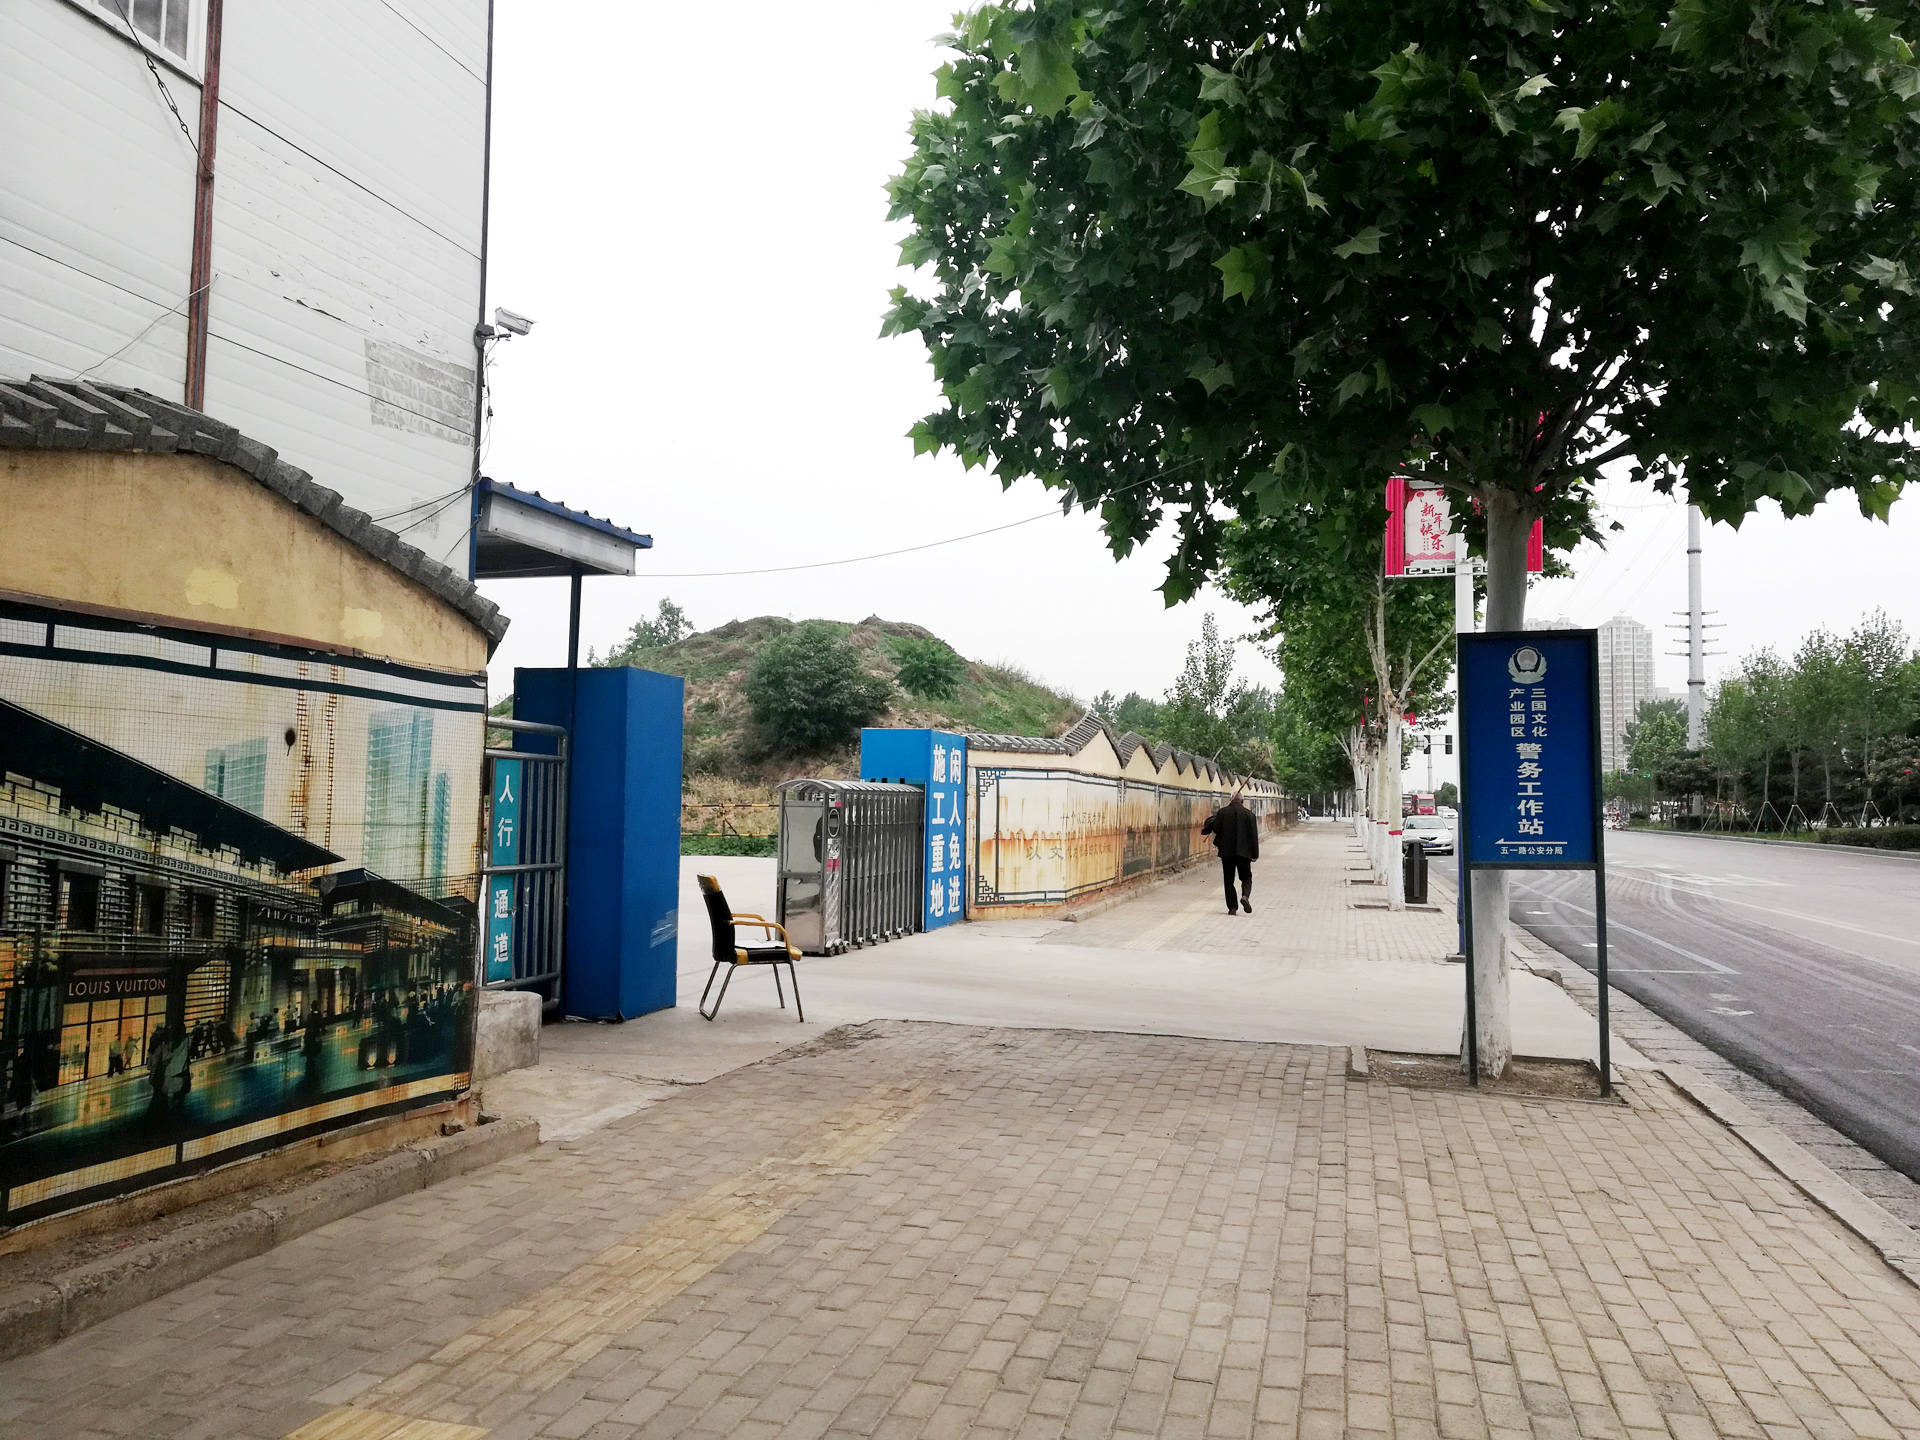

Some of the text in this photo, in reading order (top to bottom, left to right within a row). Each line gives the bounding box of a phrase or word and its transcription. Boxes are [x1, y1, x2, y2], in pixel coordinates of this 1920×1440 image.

[1509, 688, 1526, 738] 产业园区
[1530, 688, 1548, 738] 三国文化
[1516, 742, 1544, 835] 警务工作站
[930, 744, 946, 918] 施工重地
[948, 747, 962, 915] 闲人免进
[1500, 846, 1563, 855] 五一路公安分局
[68, 978, 167, 997] LOUIS VUITTON
